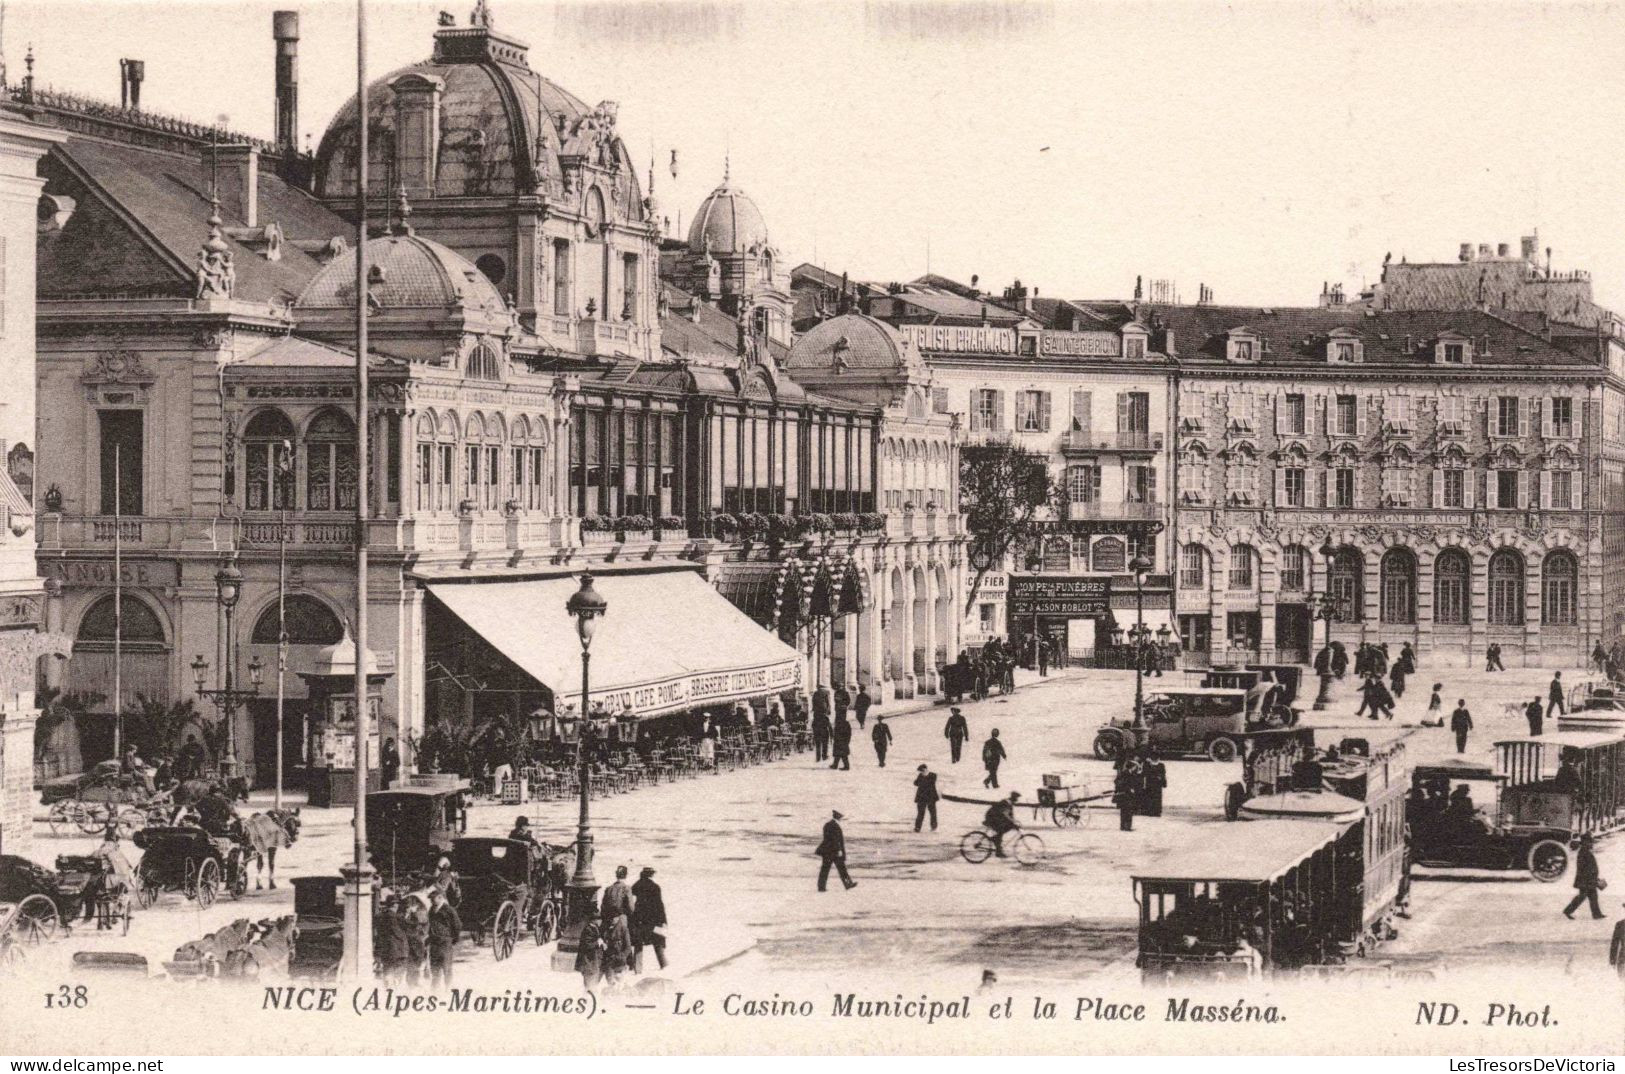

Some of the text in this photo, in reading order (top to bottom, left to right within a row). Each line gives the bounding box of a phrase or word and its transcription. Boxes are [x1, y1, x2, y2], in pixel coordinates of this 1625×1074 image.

[956, 328, 1014, 354] PHARMACY
[1436, 513, 1467, 523] NICE
[1061, 602, 1092, 612] ROBLOT
[691, 674, 728, 696] BRASSERIE
